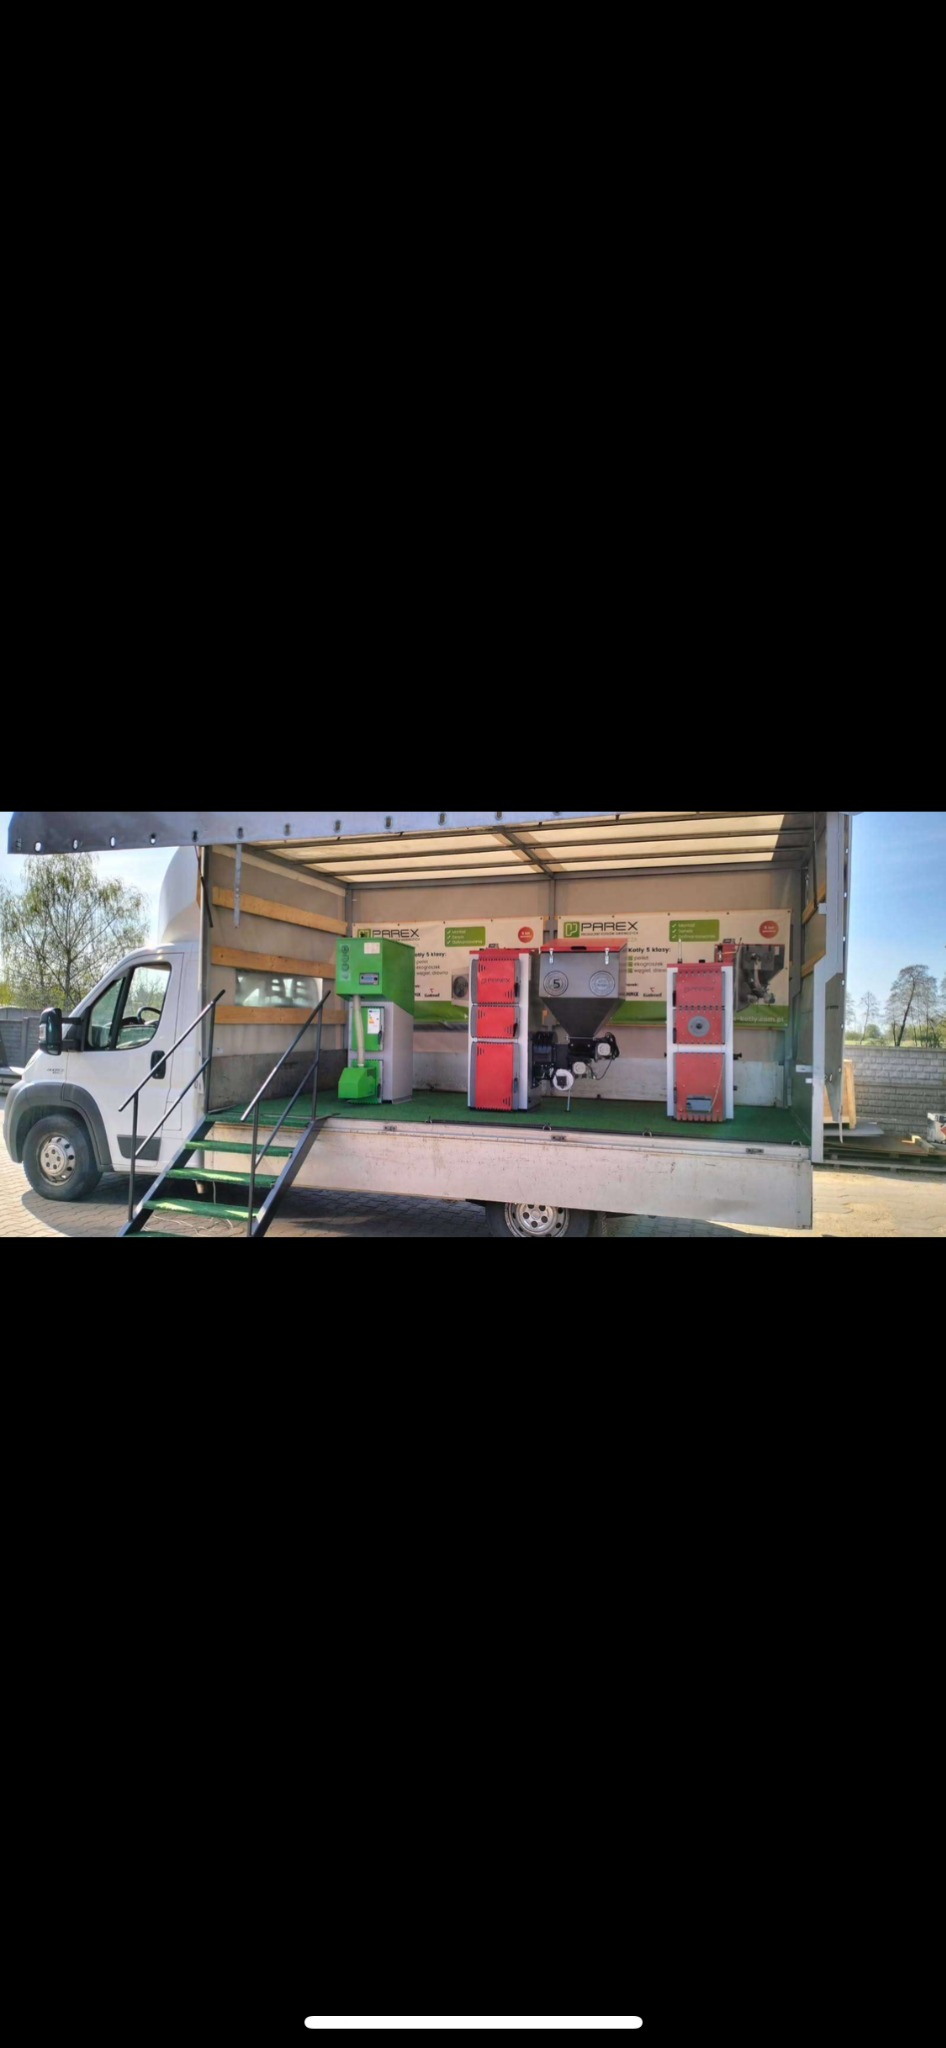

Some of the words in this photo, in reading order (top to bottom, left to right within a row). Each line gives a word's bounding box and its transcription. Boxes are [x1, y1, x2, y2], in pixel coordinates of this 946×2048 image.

[581, 921, 638, 932] PAREX
[372, 928, 420, 938] PAREX
[553, 979, 560, 989] 5
